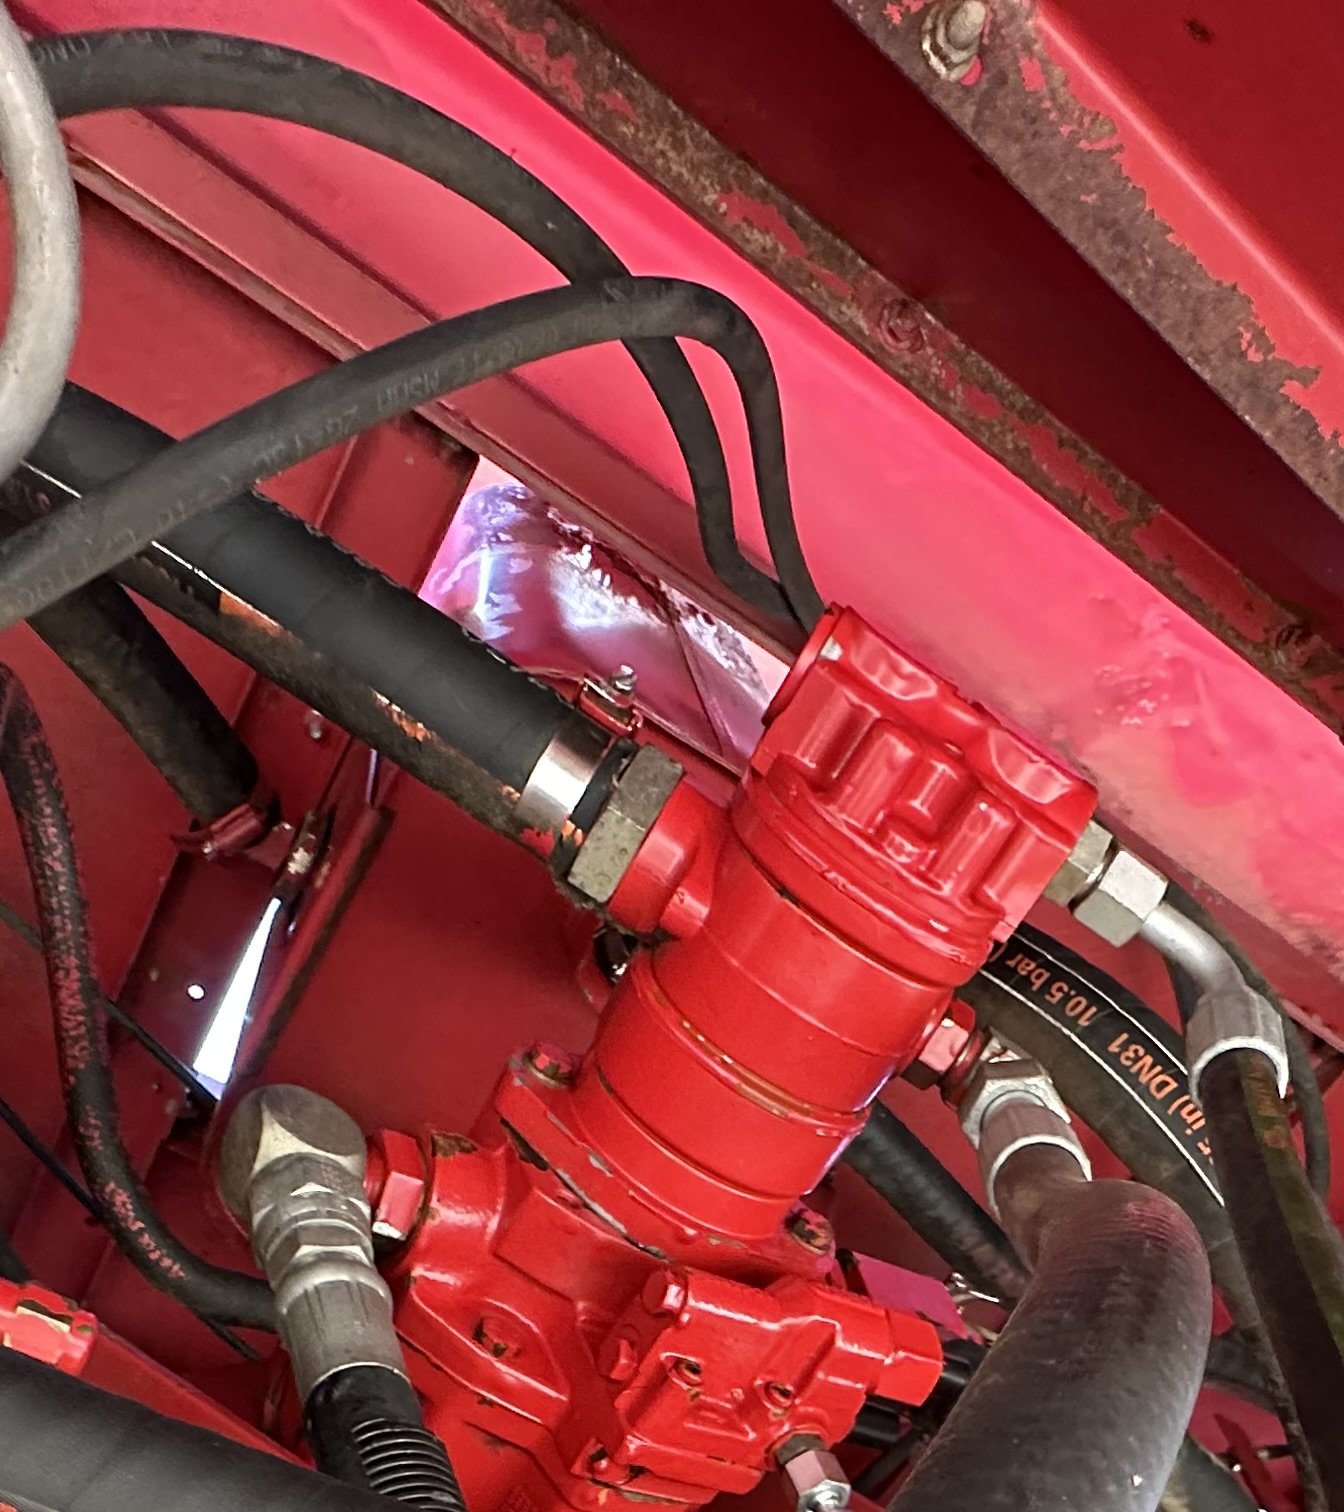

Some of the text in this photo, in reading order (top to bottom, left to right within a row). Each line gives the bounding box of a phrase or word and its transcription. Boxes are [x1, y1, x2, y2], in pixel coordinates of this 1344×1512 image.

[1006, 952, 1052, 992] bar
[1043, 981, 1098, 1027] 10.5
[1109, 1034, 1175, 1100] DN31
